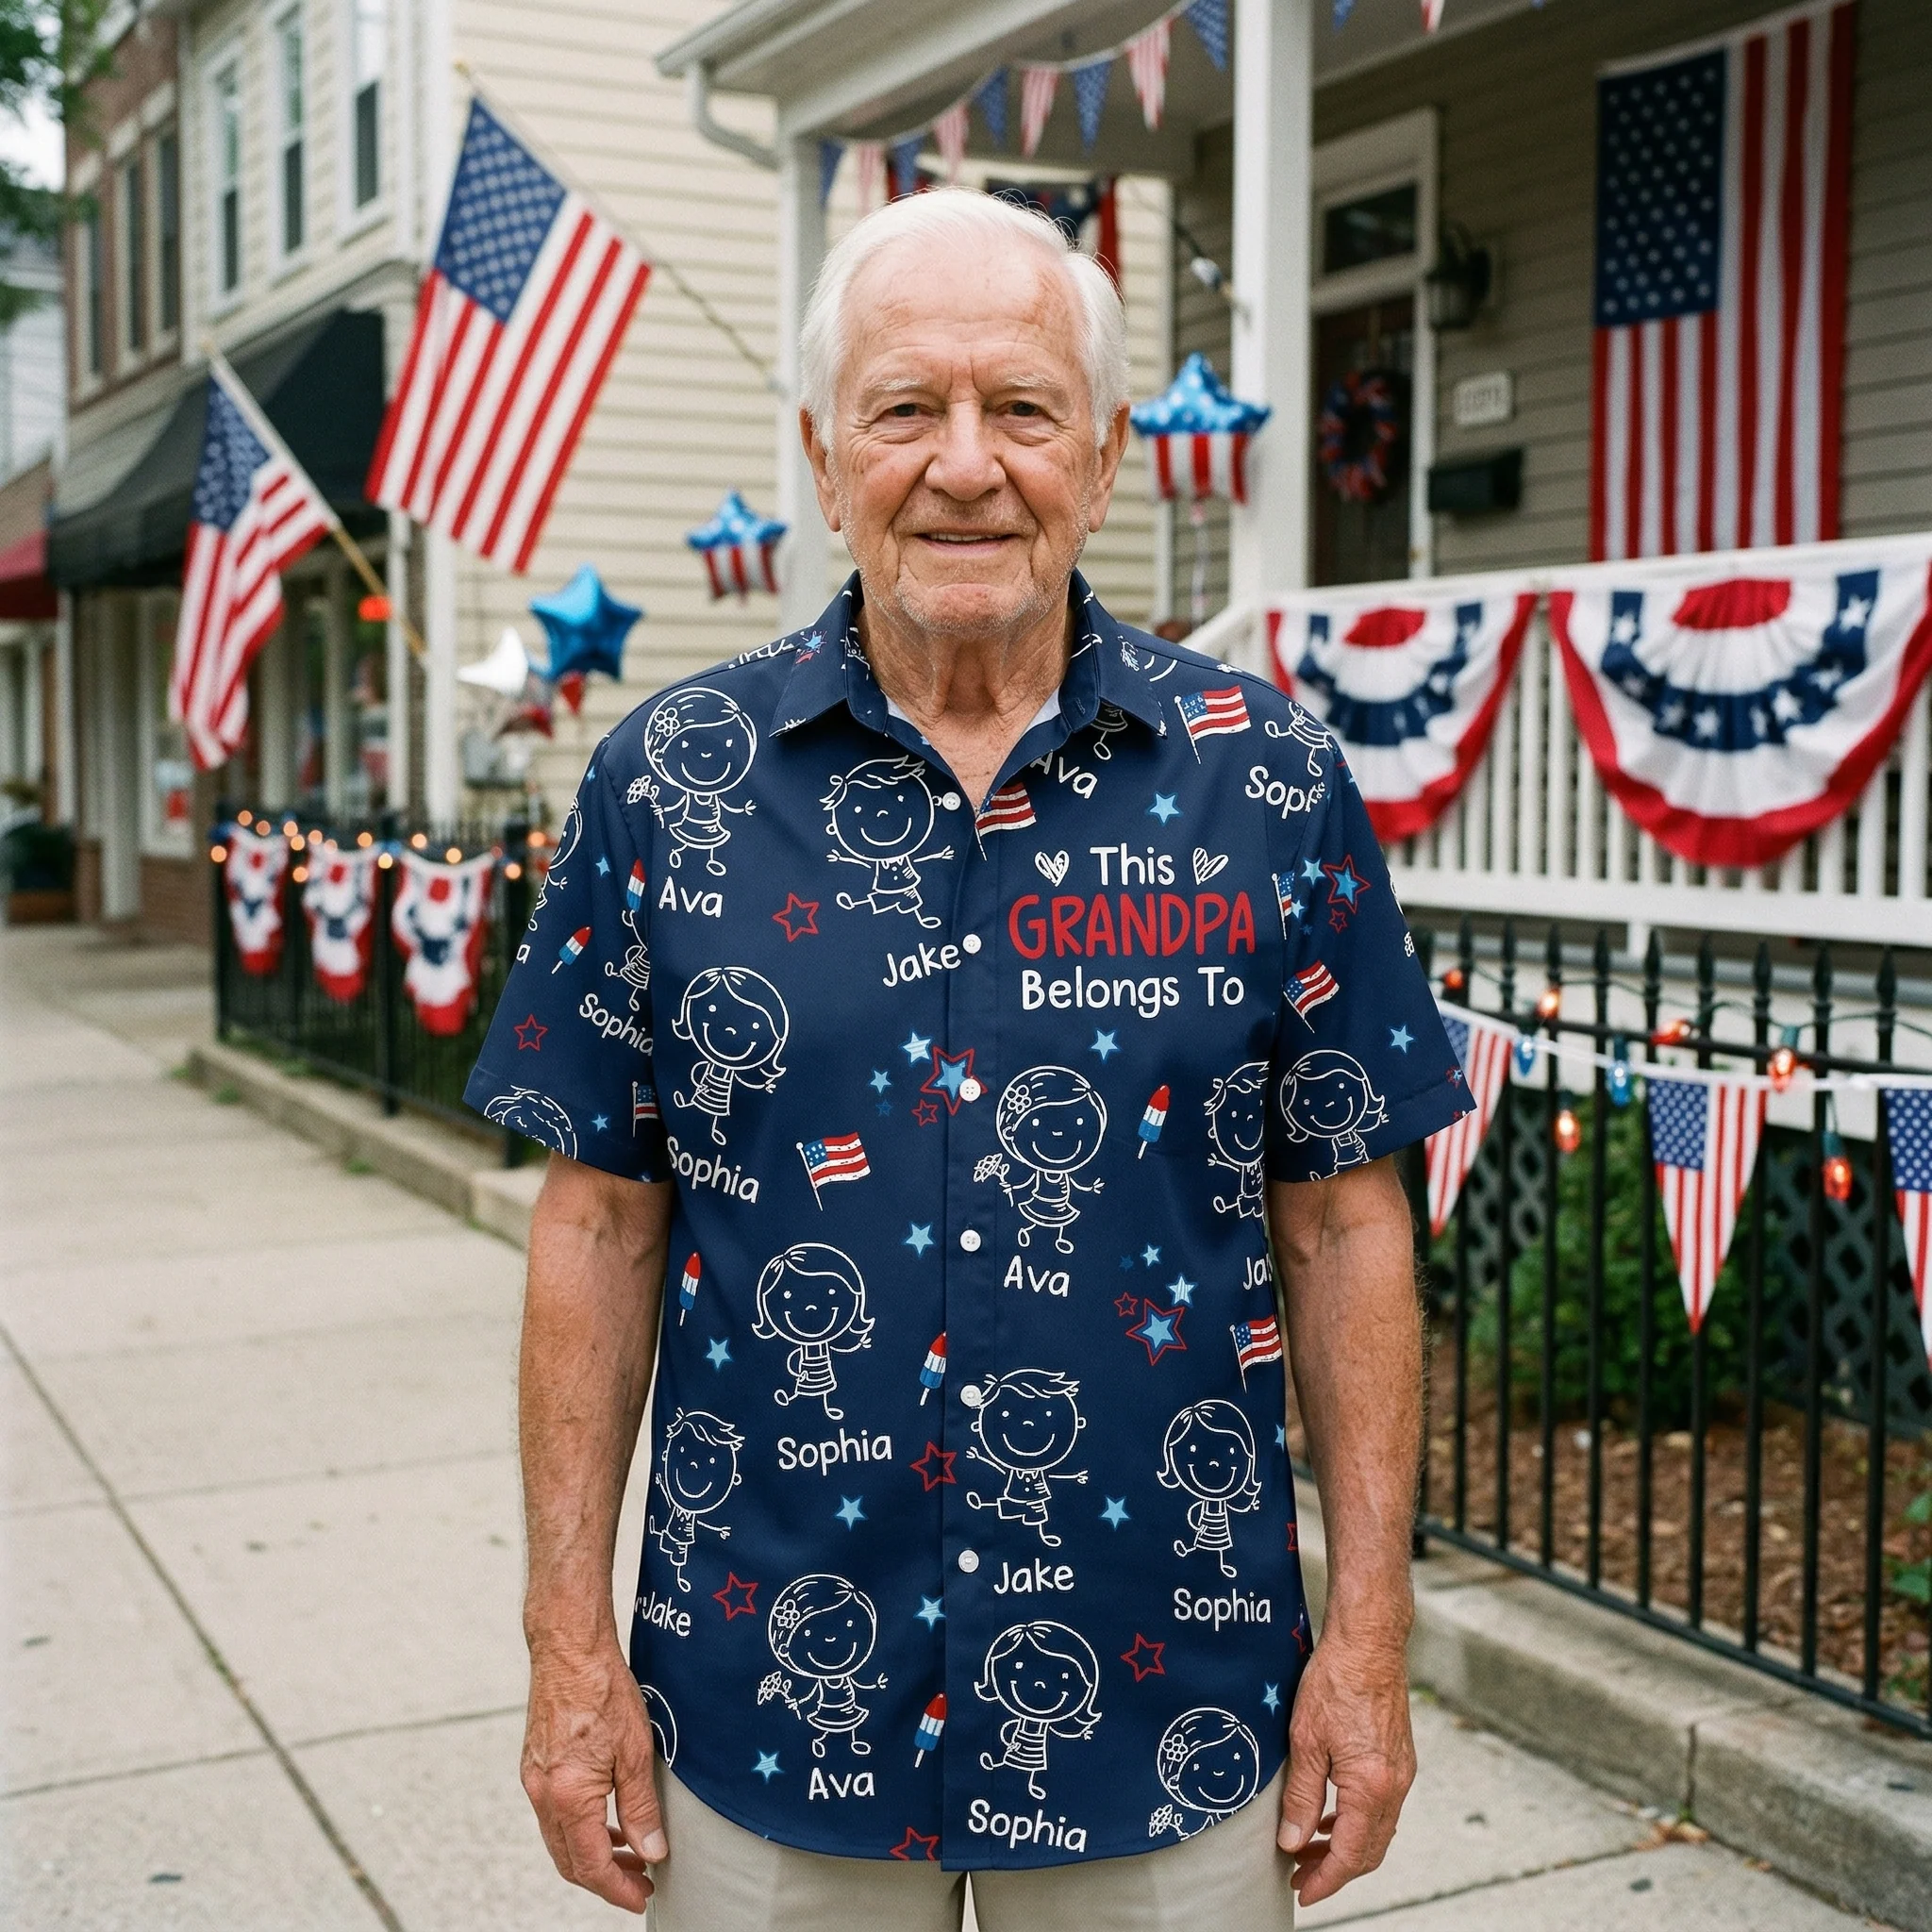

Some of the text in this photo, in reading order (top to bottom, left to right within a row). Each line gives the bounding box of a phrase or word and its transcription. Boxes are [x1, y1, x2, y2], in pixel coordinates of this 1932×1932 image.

[1029, 749, 1098, 800] Ava
[1089, 842, 1175, 887] This
[658, 875, 724, 919] Ava
[1008, 891, 1256, 960] GRANDPA
[882, 942, 961, 988] Jake
[1022, 965, 1245, 1019] Belongs To
[578, 992, 654, 1057] Sophia
[666, 1136, 759, 1204] Sophia
[1003, 1255, 1070, 1298] Ava
[777, 1427, 892, 1476] Sophia
[993, 1557, 1074, 1595] Jake
[1174, 1588, 1272, 1632] Sophia
[808, 1767, 875, 1801] Ava
[968, 1798, 1087, 1853] Sophia
